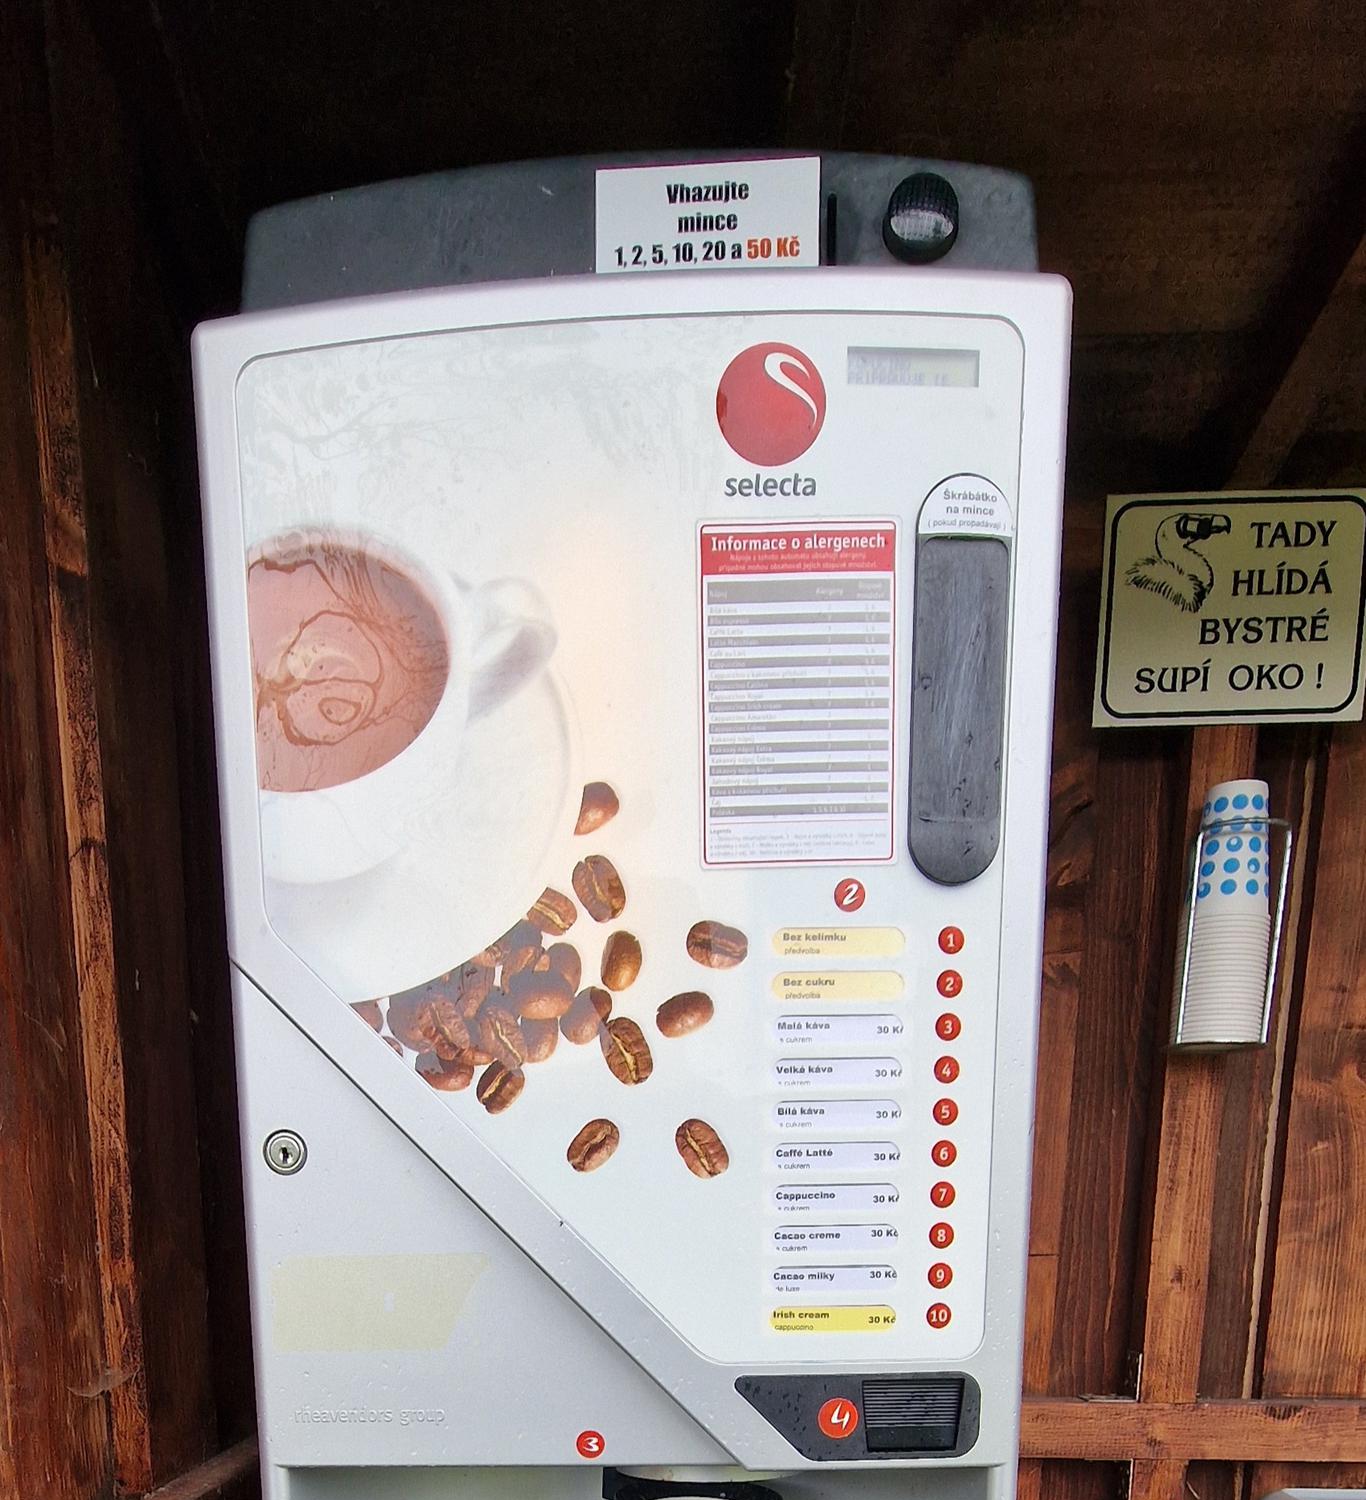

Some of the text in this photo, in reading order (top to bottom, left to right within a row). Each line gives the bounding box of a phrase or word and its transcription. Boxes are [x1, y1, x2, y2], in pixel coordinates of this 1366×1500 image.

[667, 181, 749, 204] Vhazujte
[678, 213, 738, 233] mince
[614, 236, 800, 268] 1, 2, 5, 10, 20 a 50 Kč
[724, 473, 817, 498] selecta
[943, 488, 997, 502] Škrábátko
[946, 506, 994, 516] na mince
[711, 533, 885, 552] Informace o alergenech
[1250, 521, 1337, 548] TADY
[1231, 560, 1332, 596] HLÍDÁ
[1199, 608, 1330, 645] BYSTRÉ
[1134, 659, 1324, 693] SUPÍ OKO !
[843, 883, 858, 905] 2
[783, 933, 801, 941] Bez
[947, 934, 954, 947] 1
[783, 978, 954, 991] Bez cukru 2
[778, 1022, 802, 1030] Malá
[806, 1022, 830, 1030] káva
[877, 1026, 889, 1034] 30
[944, 1020, 952, 1034] 3
[776, 1066, 805, 1074] Velká
[809, 1065, 833, 1073] káva
[875, 1070, 887, 1078] 30
[942, 1063, 951, 1077] 4
[778, 1107, 797, 1115] Bílá
[800, 1107, 825, 1115] káva
[876, 1111, 888, 1119] 30
[941, 1106, 949, 1119] 5
[776, 1149, 802, 1158] Caffé
[806, 1149, 833, 1157] Latté
[874, 1153, 886, 1161] 30
[940, 1147, 948, 1161] 6
[776, 1192, 835, 1201] Cappuccino
[873, 1195, 885, 1203] 30
[939, 1188, 947, 1201] 7
[774, 1232, 805, 1240] Cacao
[809, 1232, 840, 1240] creme
[937, 1229, 946, 1242] 8
[774, 1272, 805, 1280] Cacao
[808, 1272, 834, 1281] milky
[936, 1269, 945, 1282] 9
[773, 1311, 795, 1319] Irish
[869, 1316, 880, 1324] 30
[931, 1309, 947, 1323] 10
[399, 1408, 446, 1426] group
[830, 1402, 850, 1431] 4
[581, 1436, 599, 1452] 3
